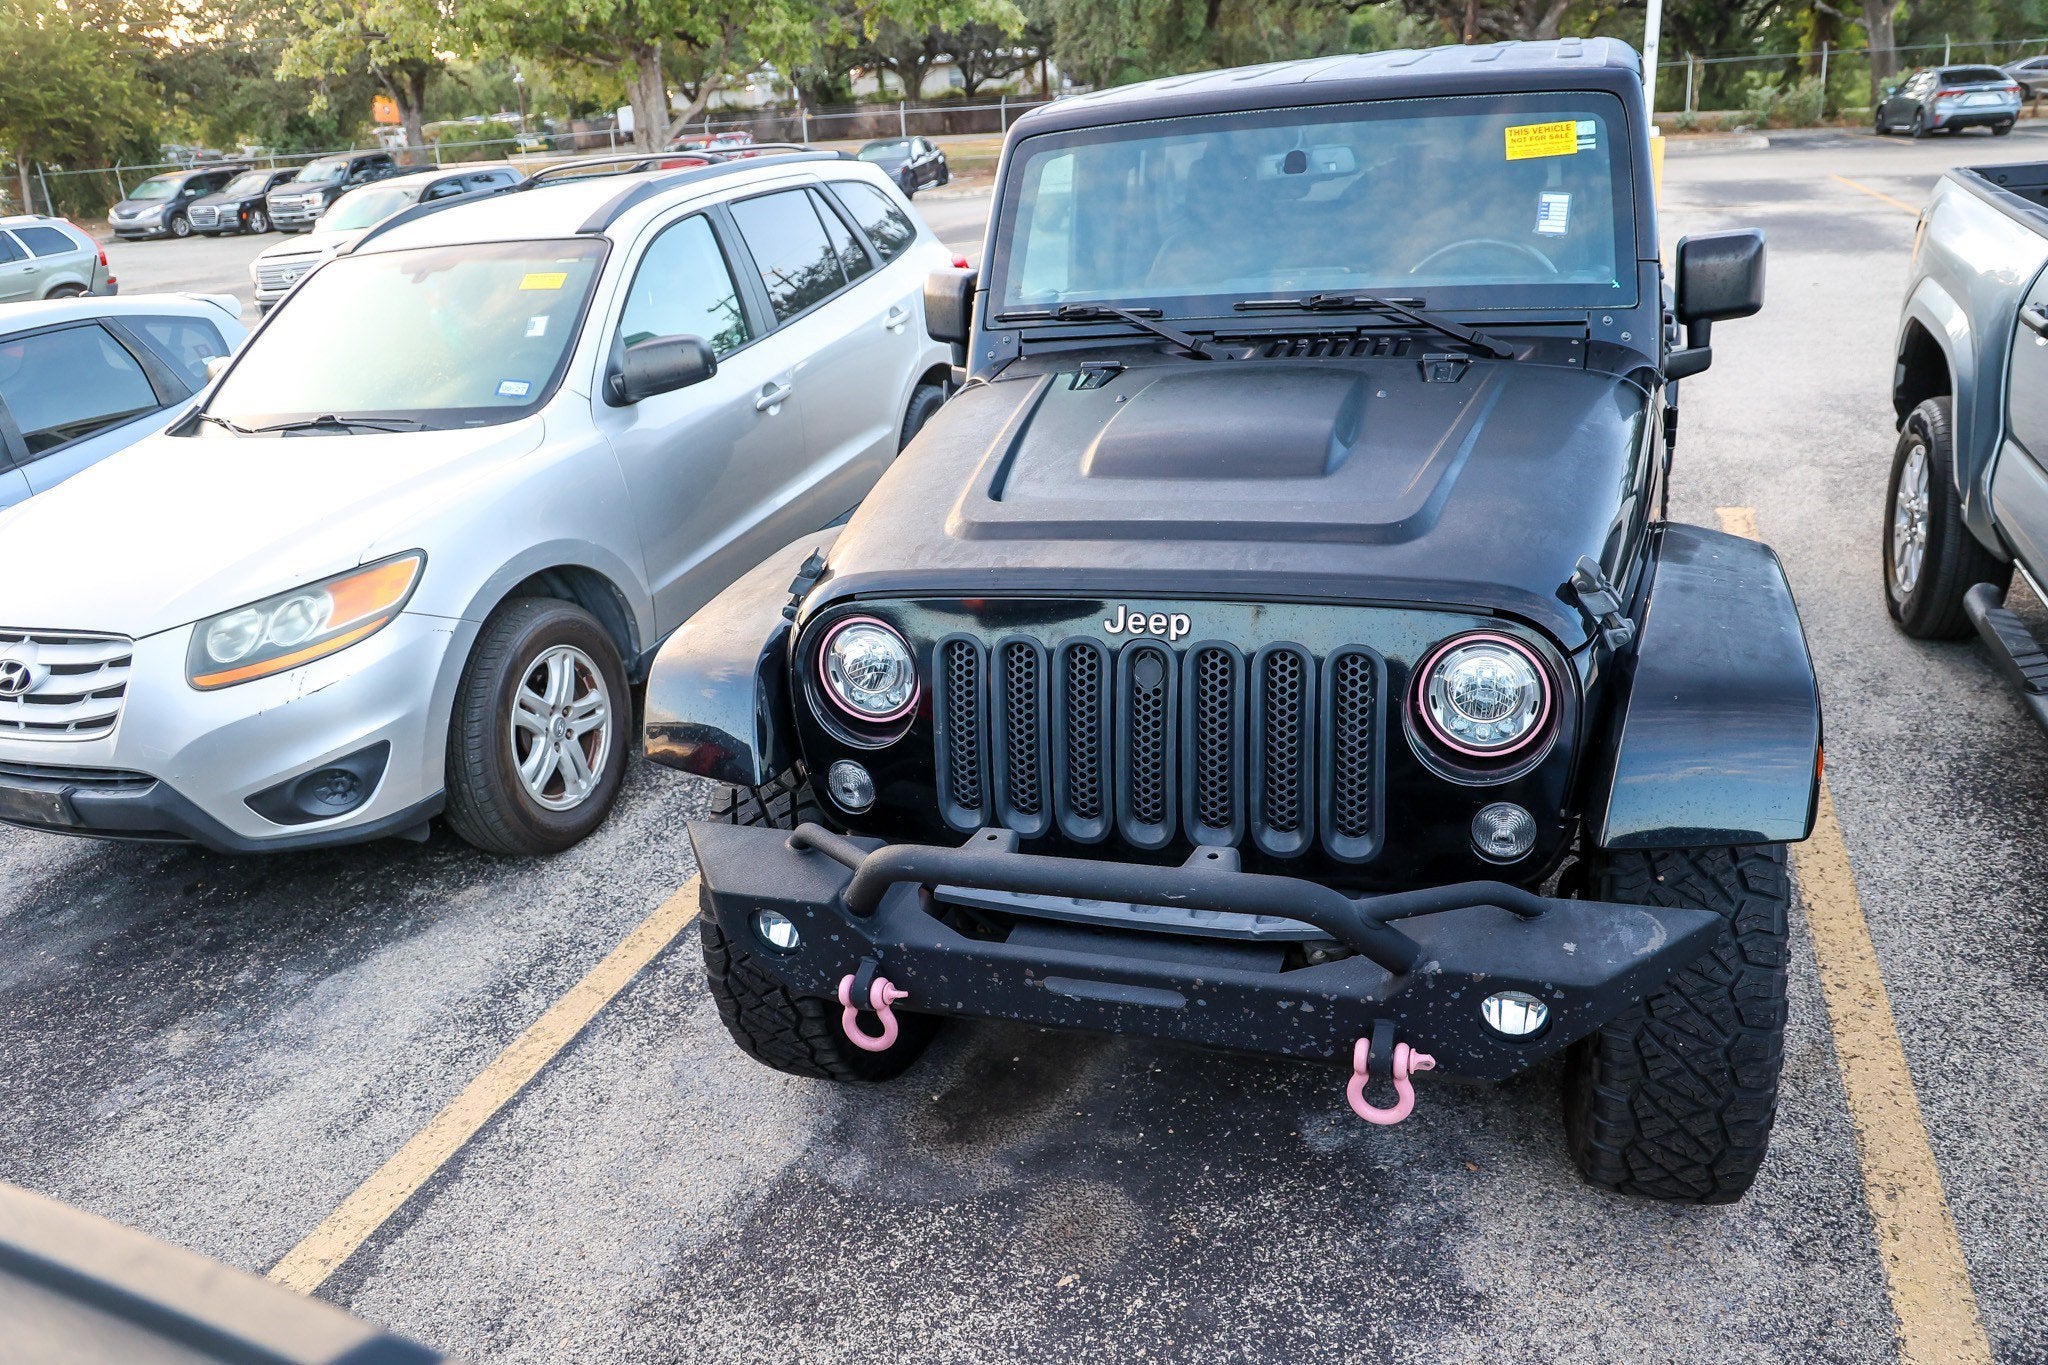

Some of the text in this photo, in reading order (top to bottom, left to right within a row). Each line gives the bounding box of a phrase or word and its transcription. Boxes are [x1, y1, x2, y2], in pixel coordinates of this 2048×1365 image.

[1508, 123, 1572, 137] THIS VEHICLE
[1511, 132, 1570, 144] NOT FOR SALE
[1103, 604, 1192, 641] Jeep
